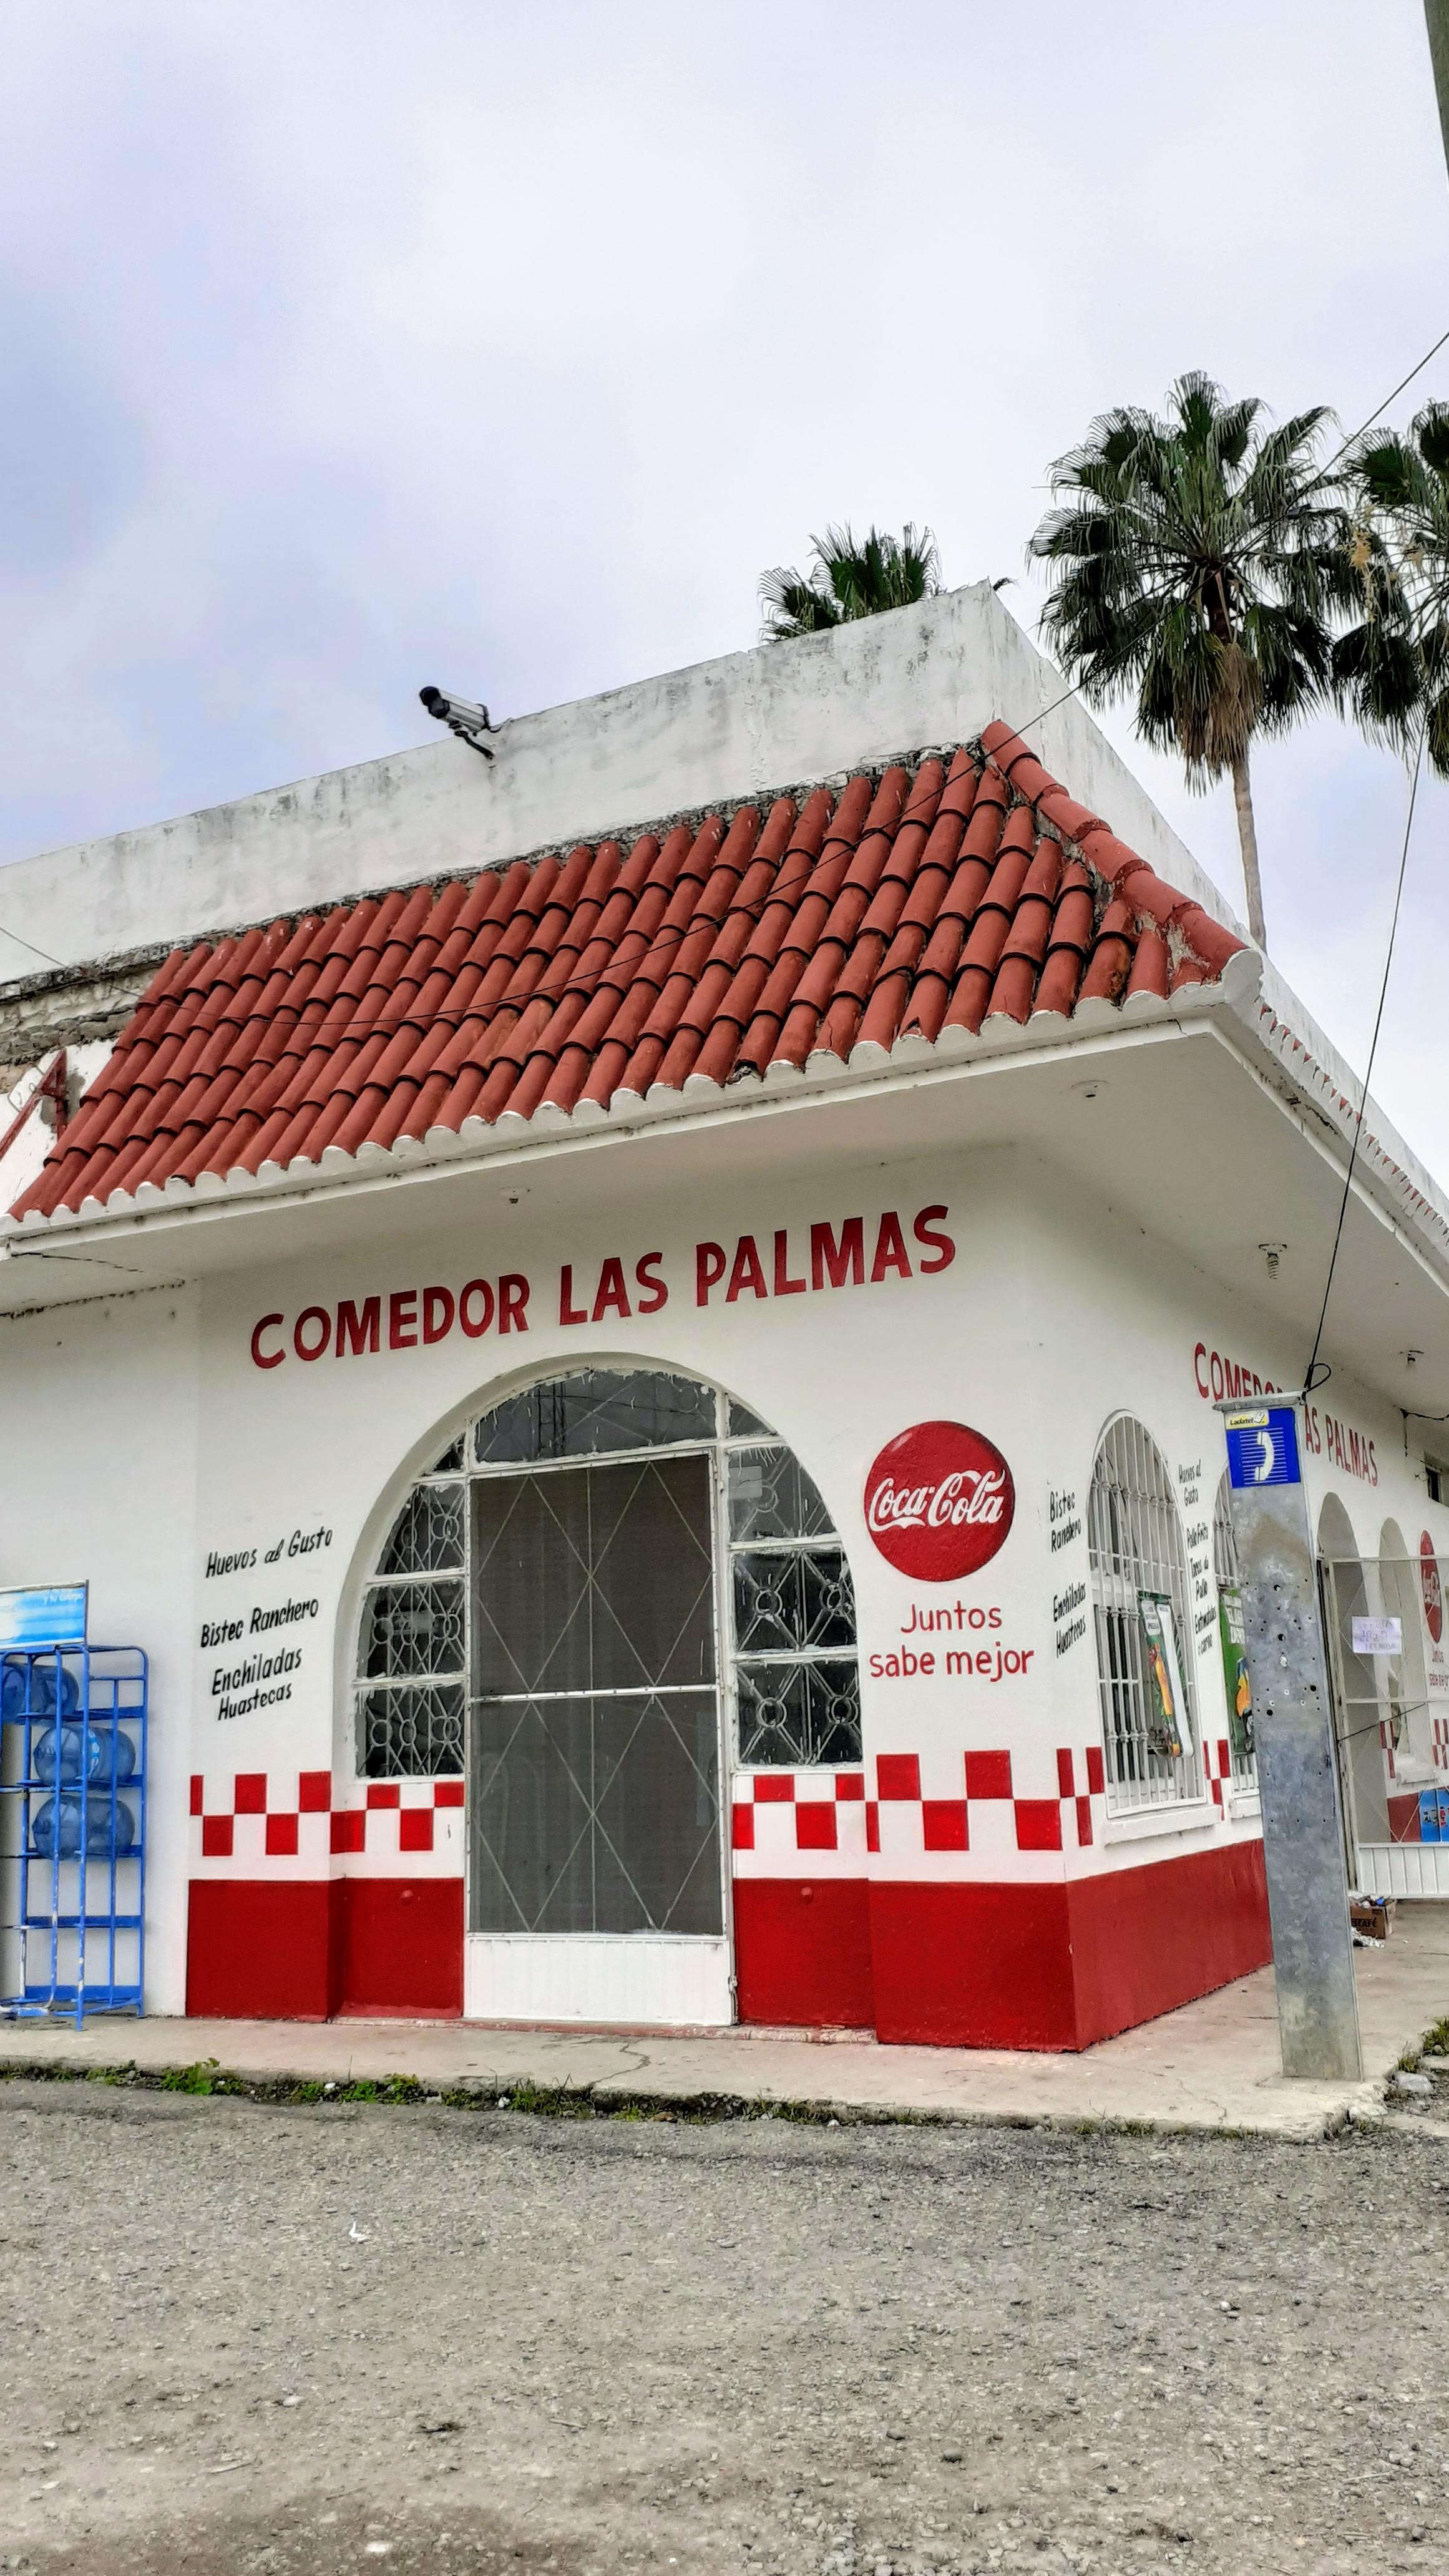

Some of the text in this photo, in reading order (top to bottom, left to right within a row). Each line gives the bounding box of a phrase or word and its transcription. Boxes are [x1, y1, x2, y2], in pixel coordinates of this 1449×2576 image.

[251, 1205, 955, 1369] COMEDOR LAS PALMAS
[1194, 1342, 1378, 1486] COME AS PALMAS
[1230, 1417, 1254, 1425] Ladatel
[869, 1469, 1005, 1532] Coca-Cola
[1050, 1489, 1075, 1523] Bistec
[1184, 1485, 1198, 1507] Gusto
[205, 1526, 333, 1578] Huevos al Gusto
[1051, 1516, 1081, 1553] Ranchero
[1053, 1581, 1086, 1622] Enchiladas
[1196, 1578, 1208, 1602] Pollo
[201, 1598, 318, 1647] Bistec Ranchero
[900, 1601, 1003, 1634] Juntos
[1056, 1614, 1086, 1659] Huastecas
[212, 1647, 302, 1695] Enchiladas
[870, 1641, 1035, 1682] sabe mejor
[218, 1682, 293, 1720] Huastecas
